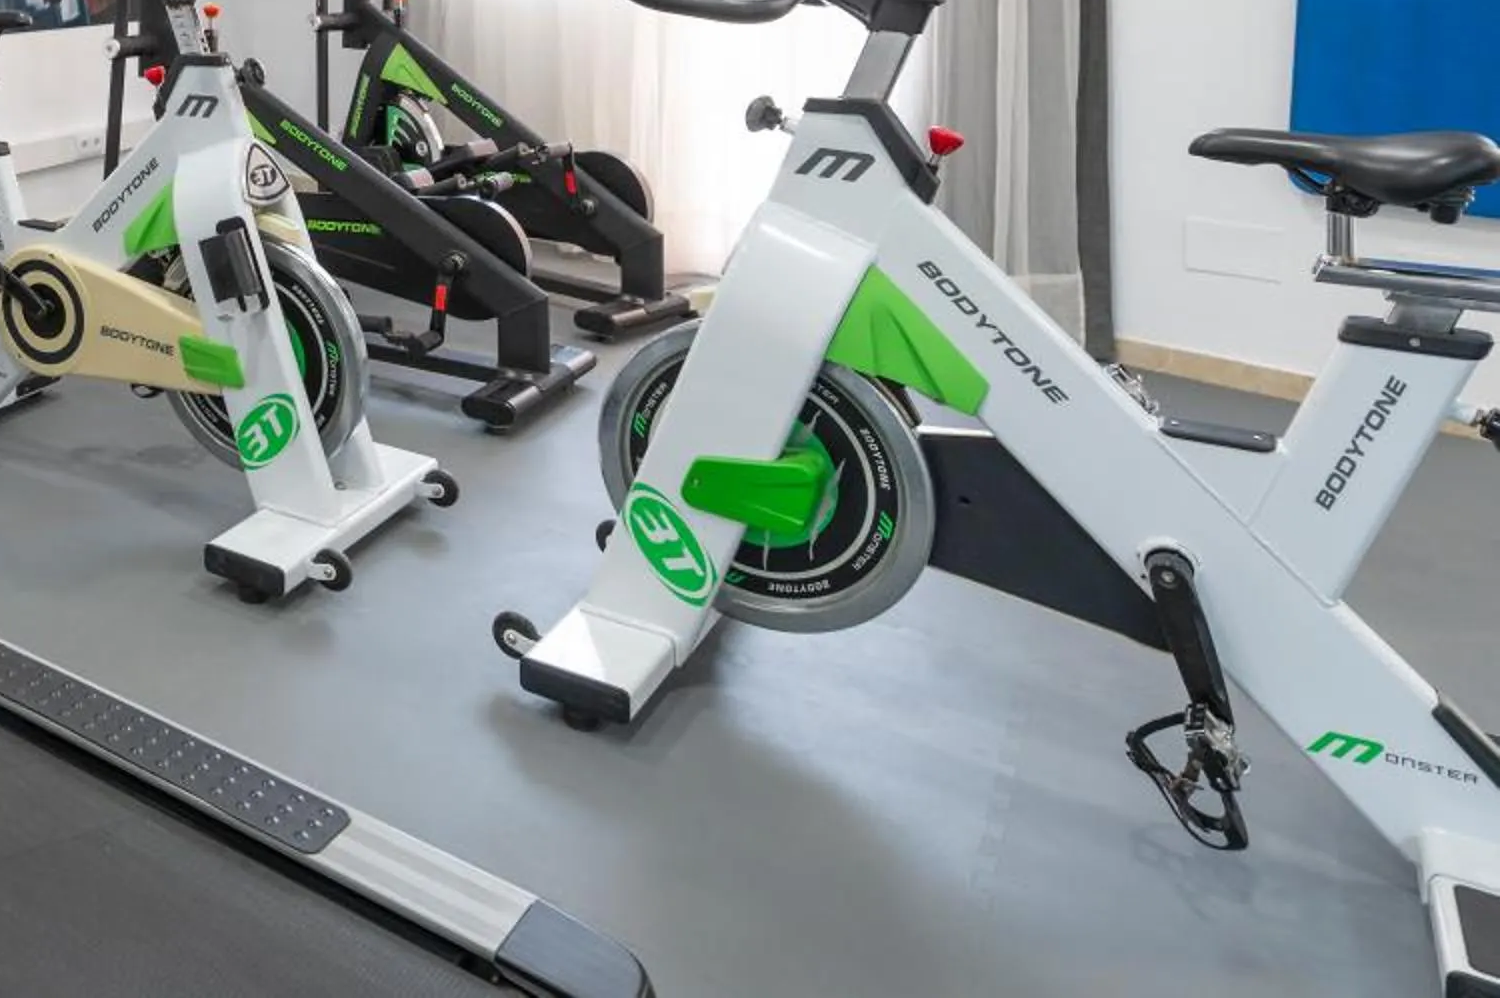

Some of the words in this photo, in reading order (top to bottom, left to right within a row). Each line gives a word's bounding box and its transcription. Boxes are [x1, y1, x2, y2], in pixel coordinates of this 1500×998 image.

[280, 119, 348, 171] BODYTONE
[92, 157, 160, 233] BODYTONE
[100, 325, 176, 358] BODYTONE
[916, 260, 1071, 406] BODYTONE
[1315, 374, 1408, 511] BODYTONE
